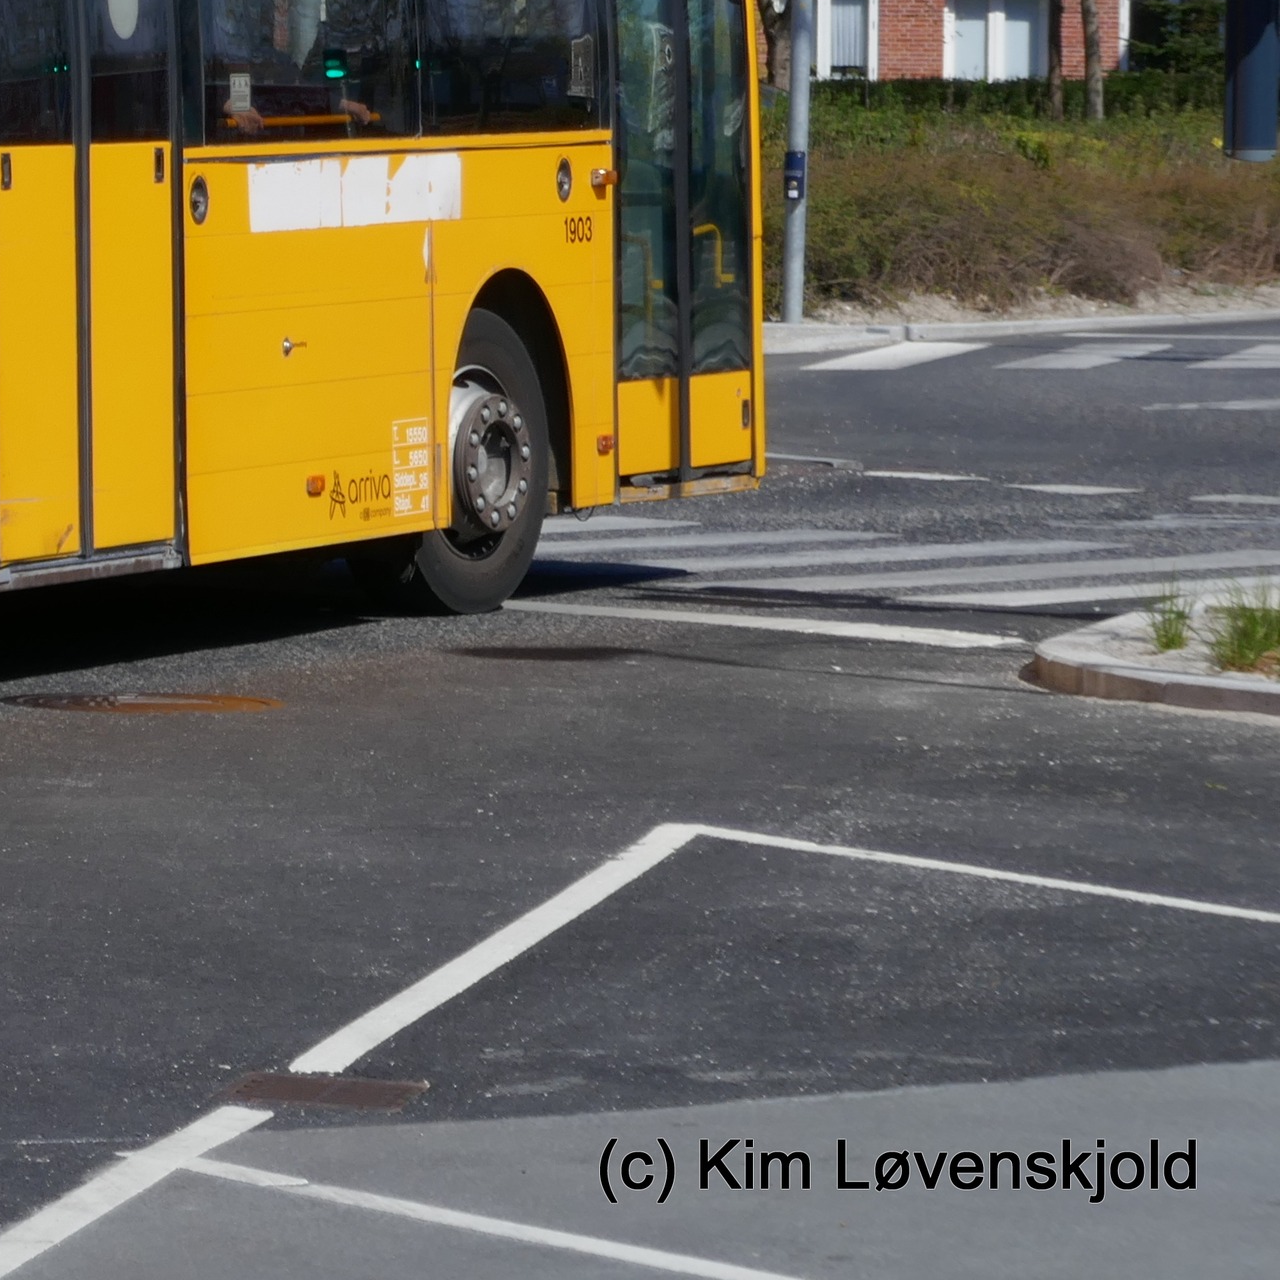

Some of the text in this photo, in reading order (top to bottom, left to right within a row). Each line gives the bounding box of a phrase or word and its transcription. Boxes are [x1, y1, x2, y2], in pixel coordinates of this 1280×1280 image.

[564, 215, 593, 244] 1903
[406, 426, 428, 443] 15550
[409, 449, 428, 466] 5650
[347, 469, 392, 505] arriva
